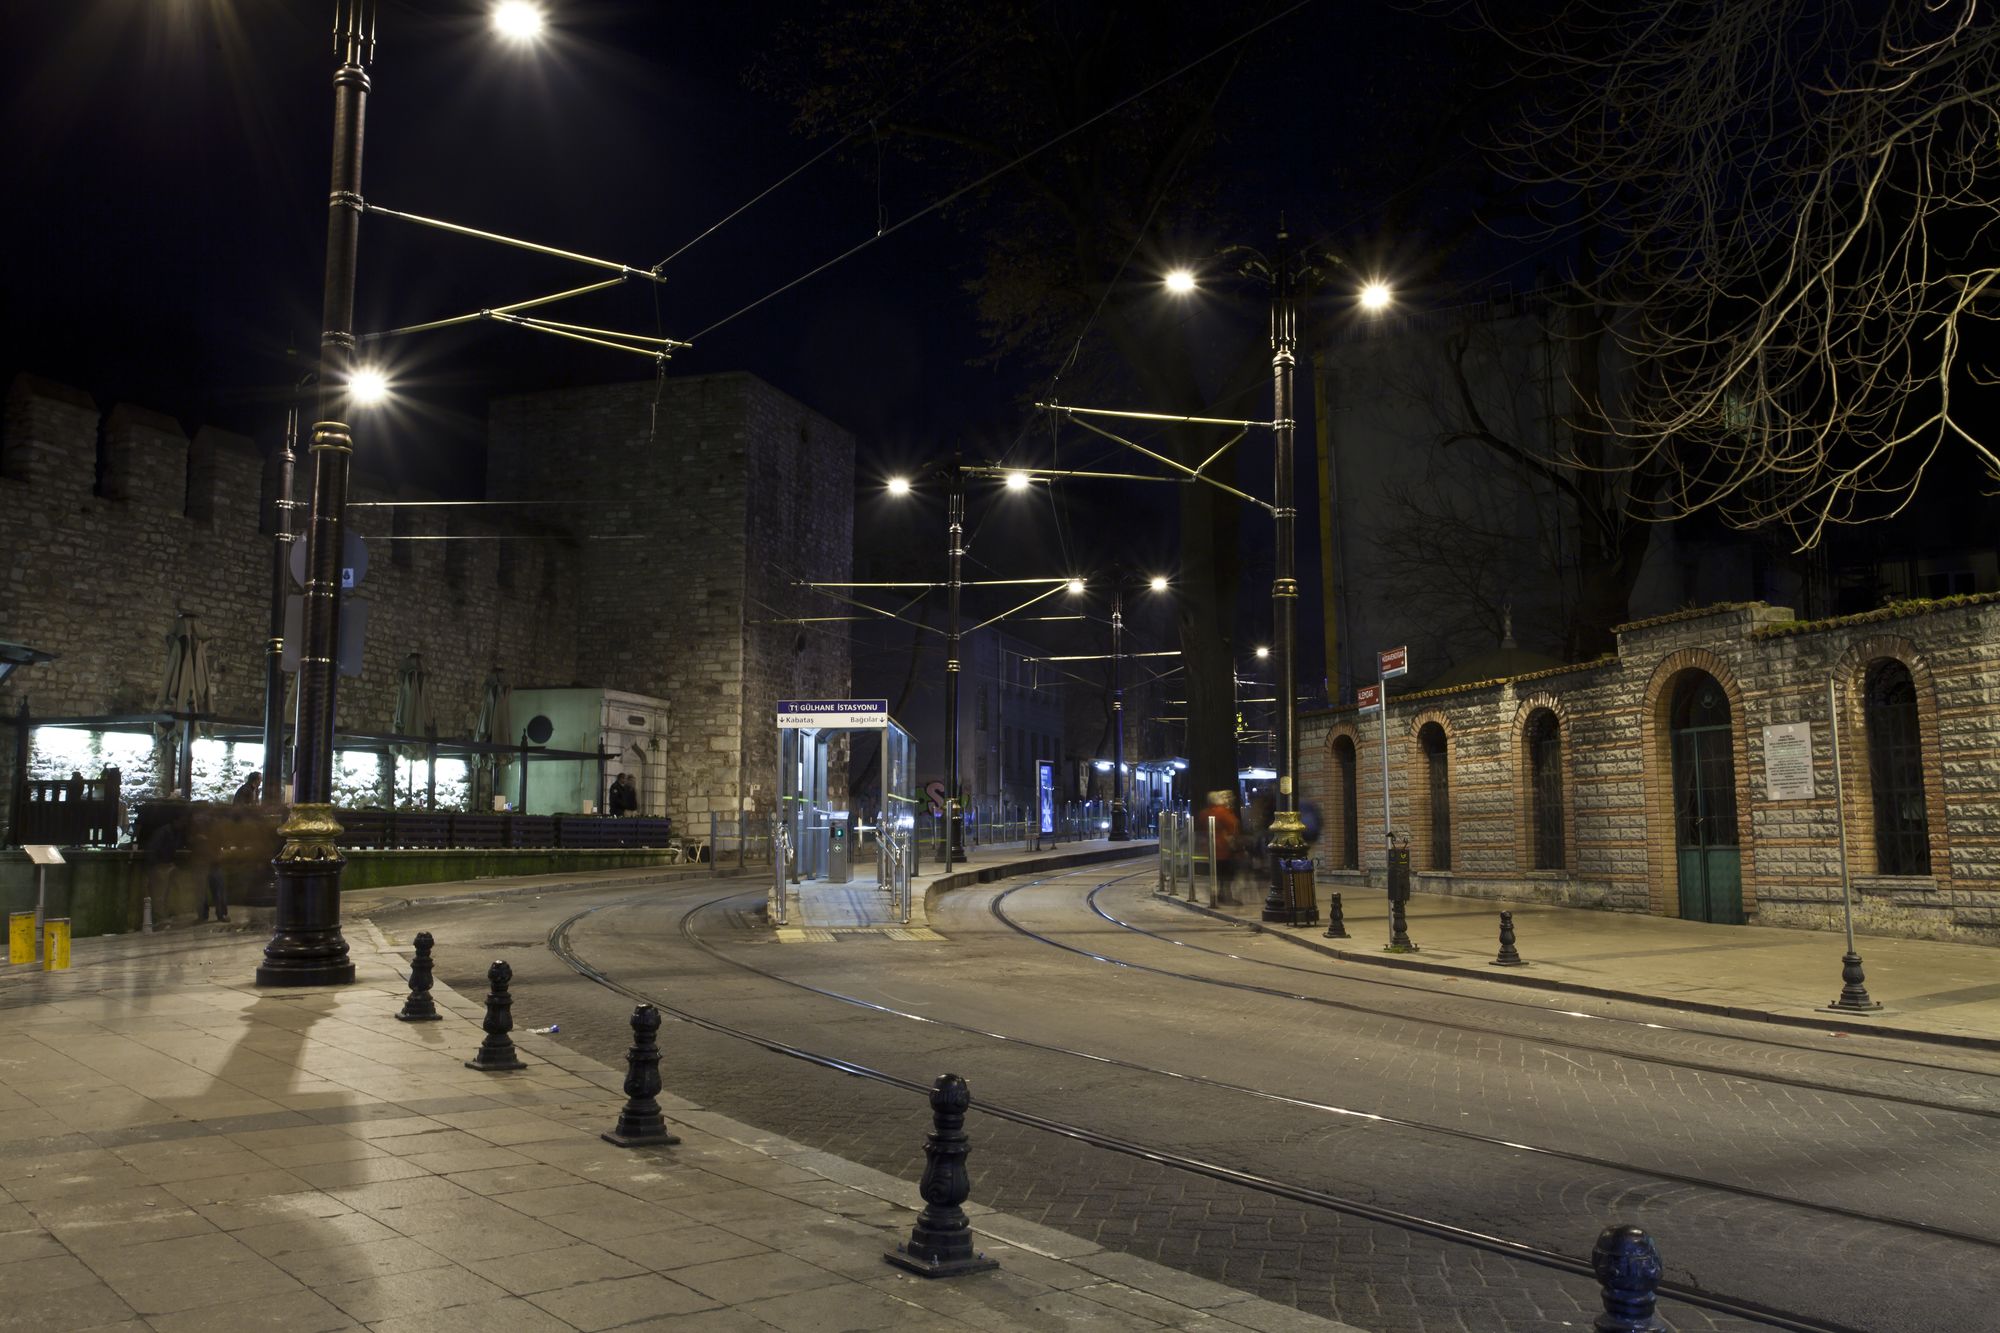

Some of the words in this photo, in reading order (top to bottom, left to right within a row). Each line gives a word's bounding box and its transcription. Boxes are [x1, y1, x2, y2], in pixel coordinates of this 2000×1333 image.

[789, 703, 799, 711] T1
[800, 703, 835, 711] GÜLHANE
[837, 703, 878, 711] İSTASYONU
[785, 716, 814, 724] Kabataş
